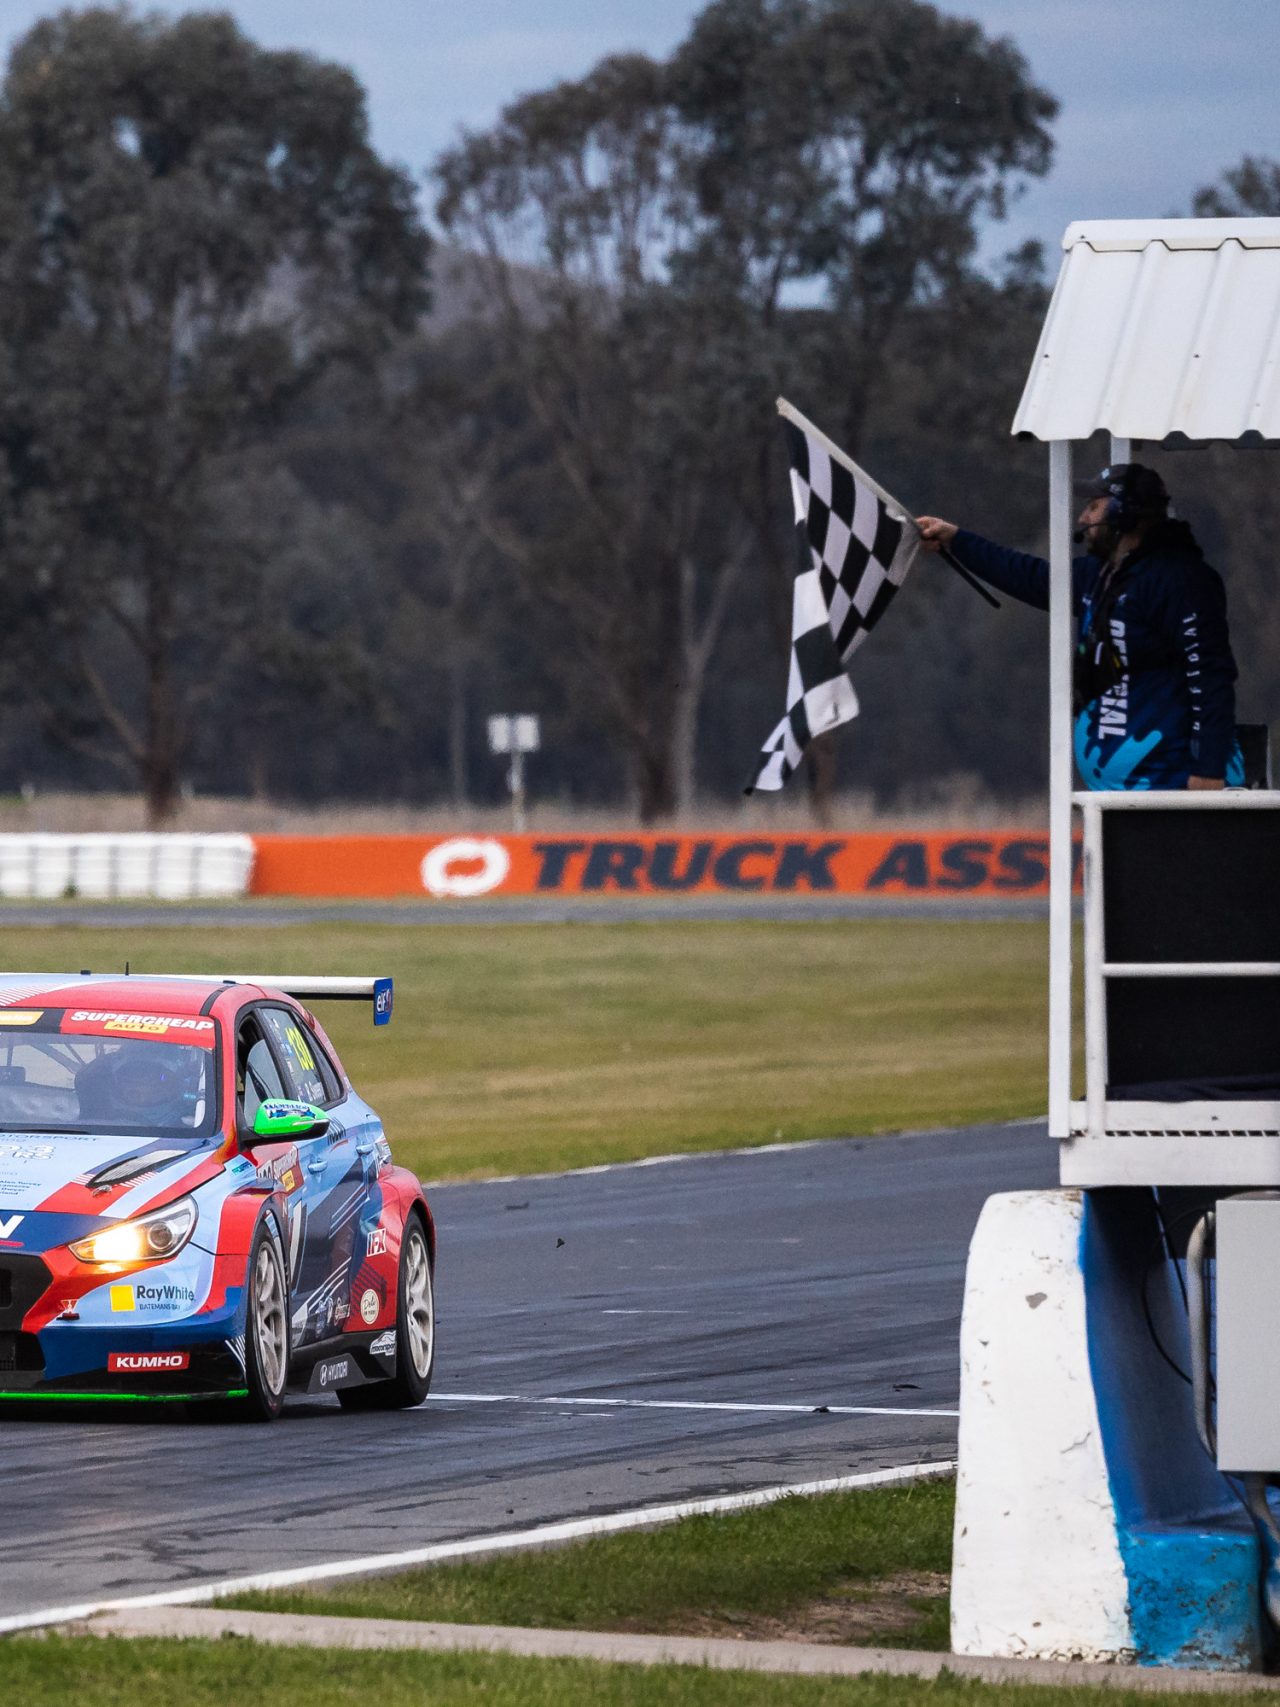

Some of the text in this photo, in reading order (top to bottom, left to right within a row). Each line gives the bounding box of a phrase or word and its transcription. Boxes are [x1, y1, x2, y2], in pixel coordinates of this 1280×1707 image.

[533, 841, 843, 891] TRUCK
[70, 1011, 215, 1031] SUPERCHEAP
[116, 1355, 183, 1369] KUMHO
